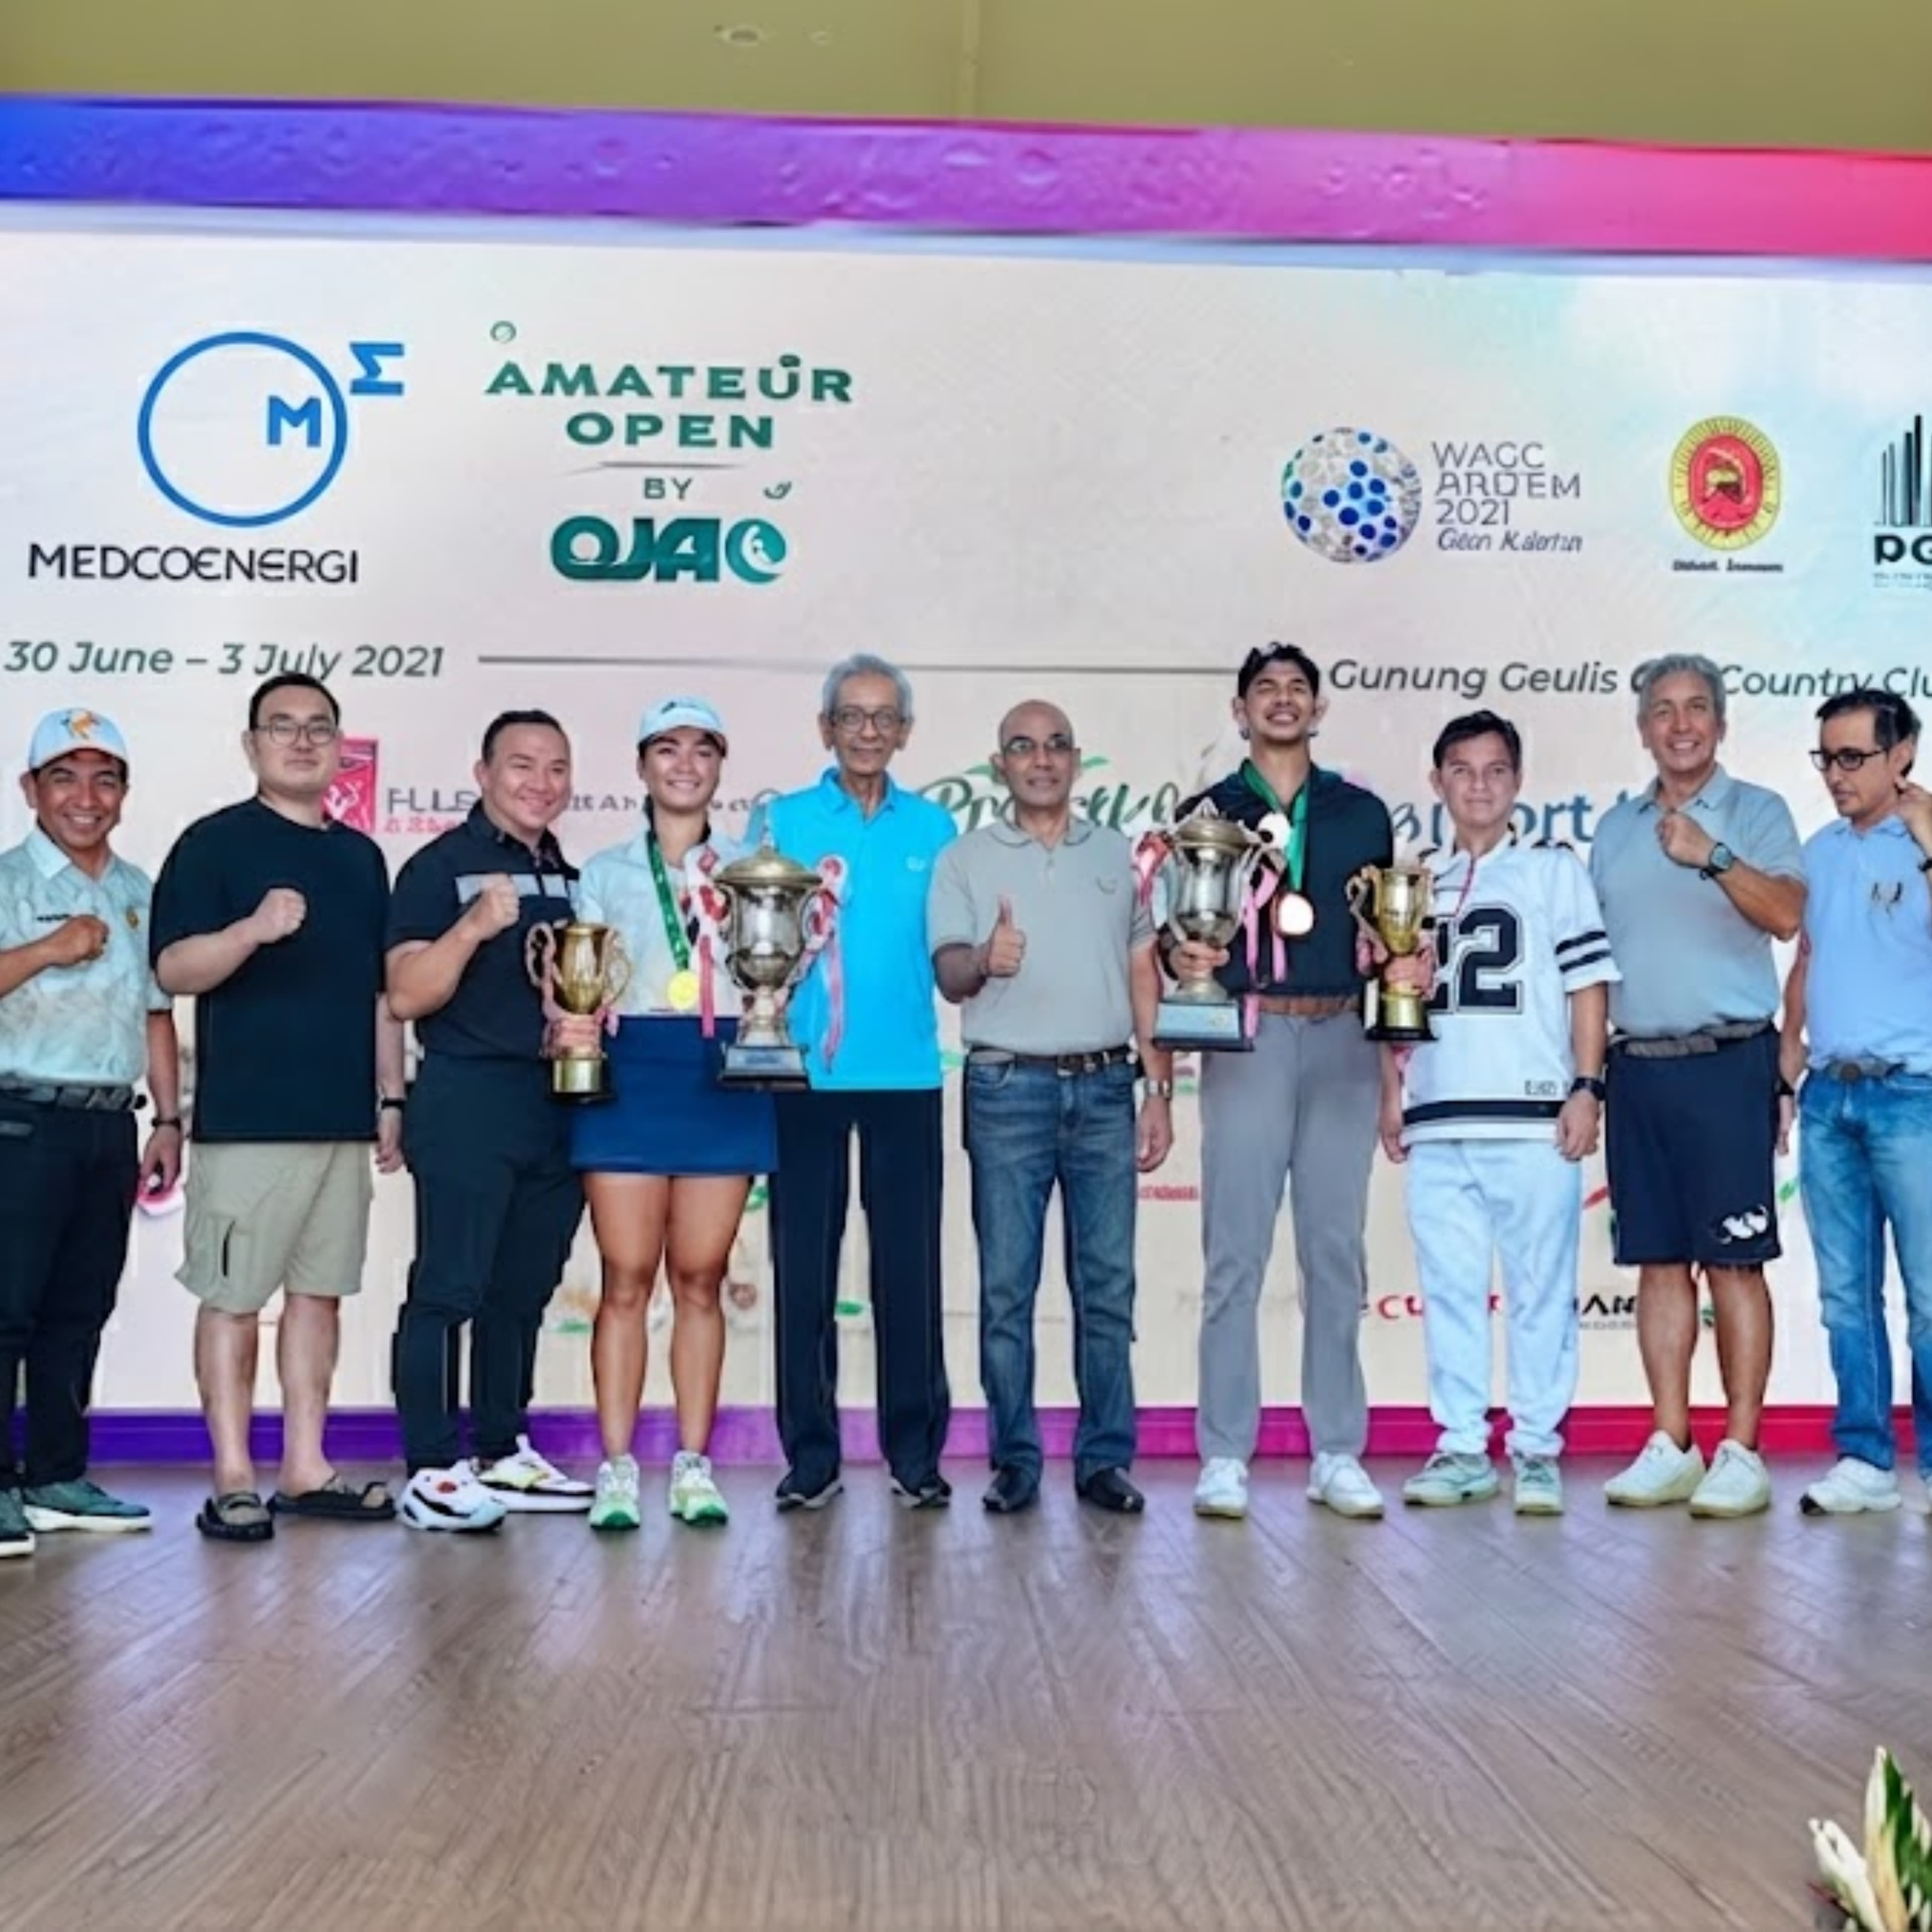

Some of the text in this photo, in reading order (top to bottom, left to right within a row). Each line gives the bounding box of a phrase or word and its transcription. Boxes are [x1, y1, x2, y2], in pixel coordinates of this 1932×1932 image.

[566, 412, 774, 448] OPEN
[643, 477, 693, 500] BY
[1435, 498, 1509, 526] 2021
[28, 543, 359, 584] MEDCOENERGI
[5, 640, 58, 673] 30
[68, 640, 173, 674] June
[218, 643, 246, 675] 3
[254, 642, 342, 681] July
[352, 645, 444, 677] 2021
[1329, 659, 1487, 700] Gunung
[1499, 661, 1619, 694] Geulis
